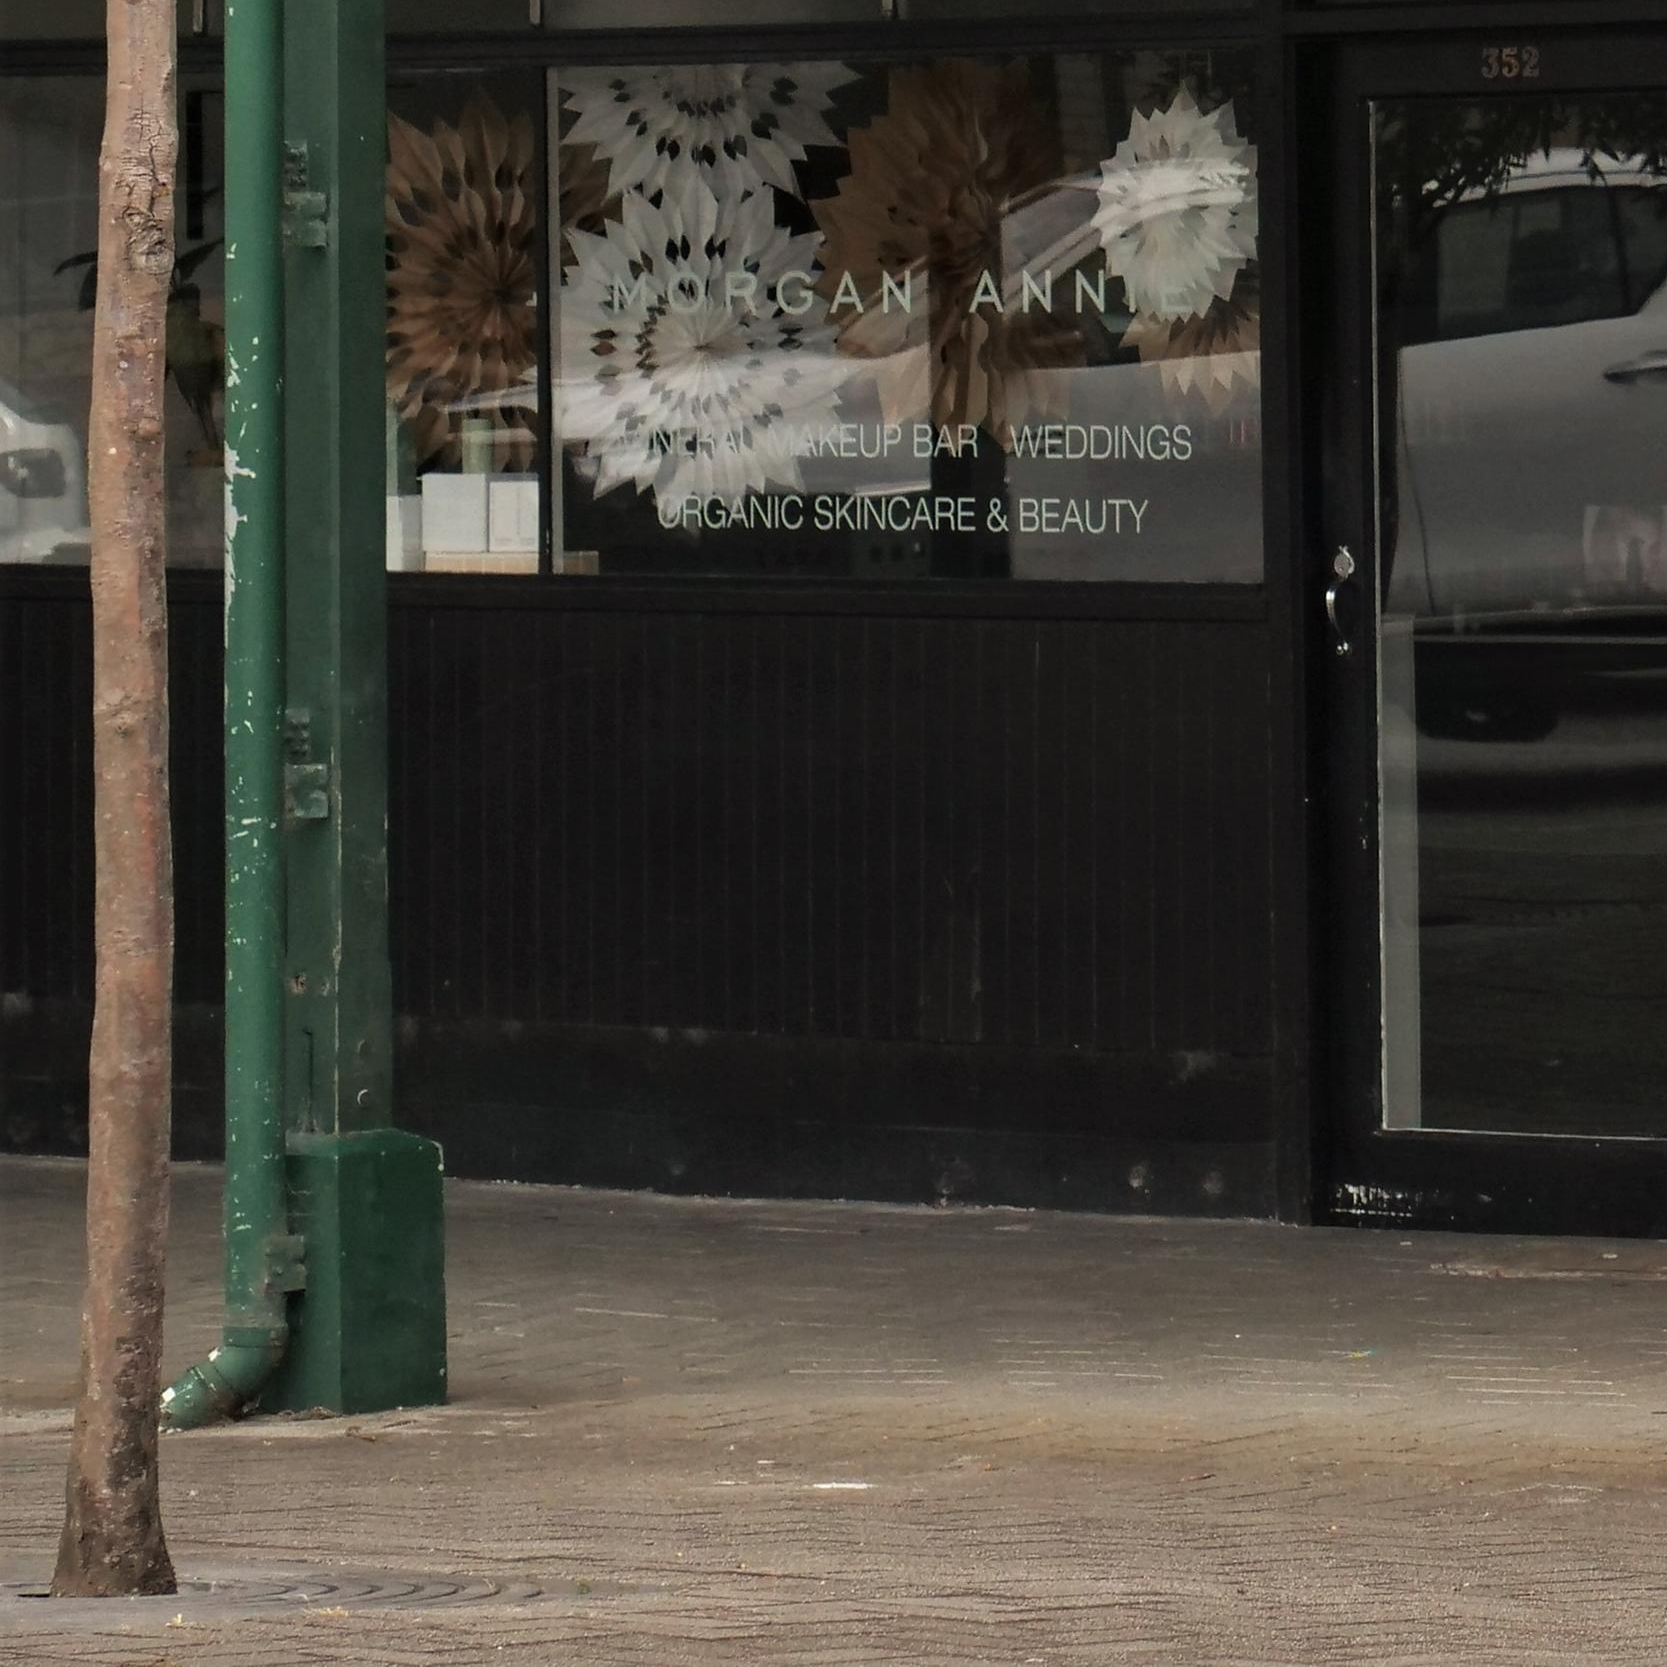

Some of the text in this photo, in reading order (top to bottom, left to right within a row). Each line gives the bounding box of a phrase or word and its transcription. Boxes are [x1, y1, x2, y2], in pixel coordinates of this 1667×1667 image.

[1480, 45, 1541, 79] 352
[612, 269, 912, 314] MORGAN
[768, 424, 901, 459] MAKEUP
[912, 424, 979, 459] BAR
[1009, 424, 1193, 460] WEDDINGS
[658, 494, 1149, 534] ORGANIC SKINCARE & BEAUTY
